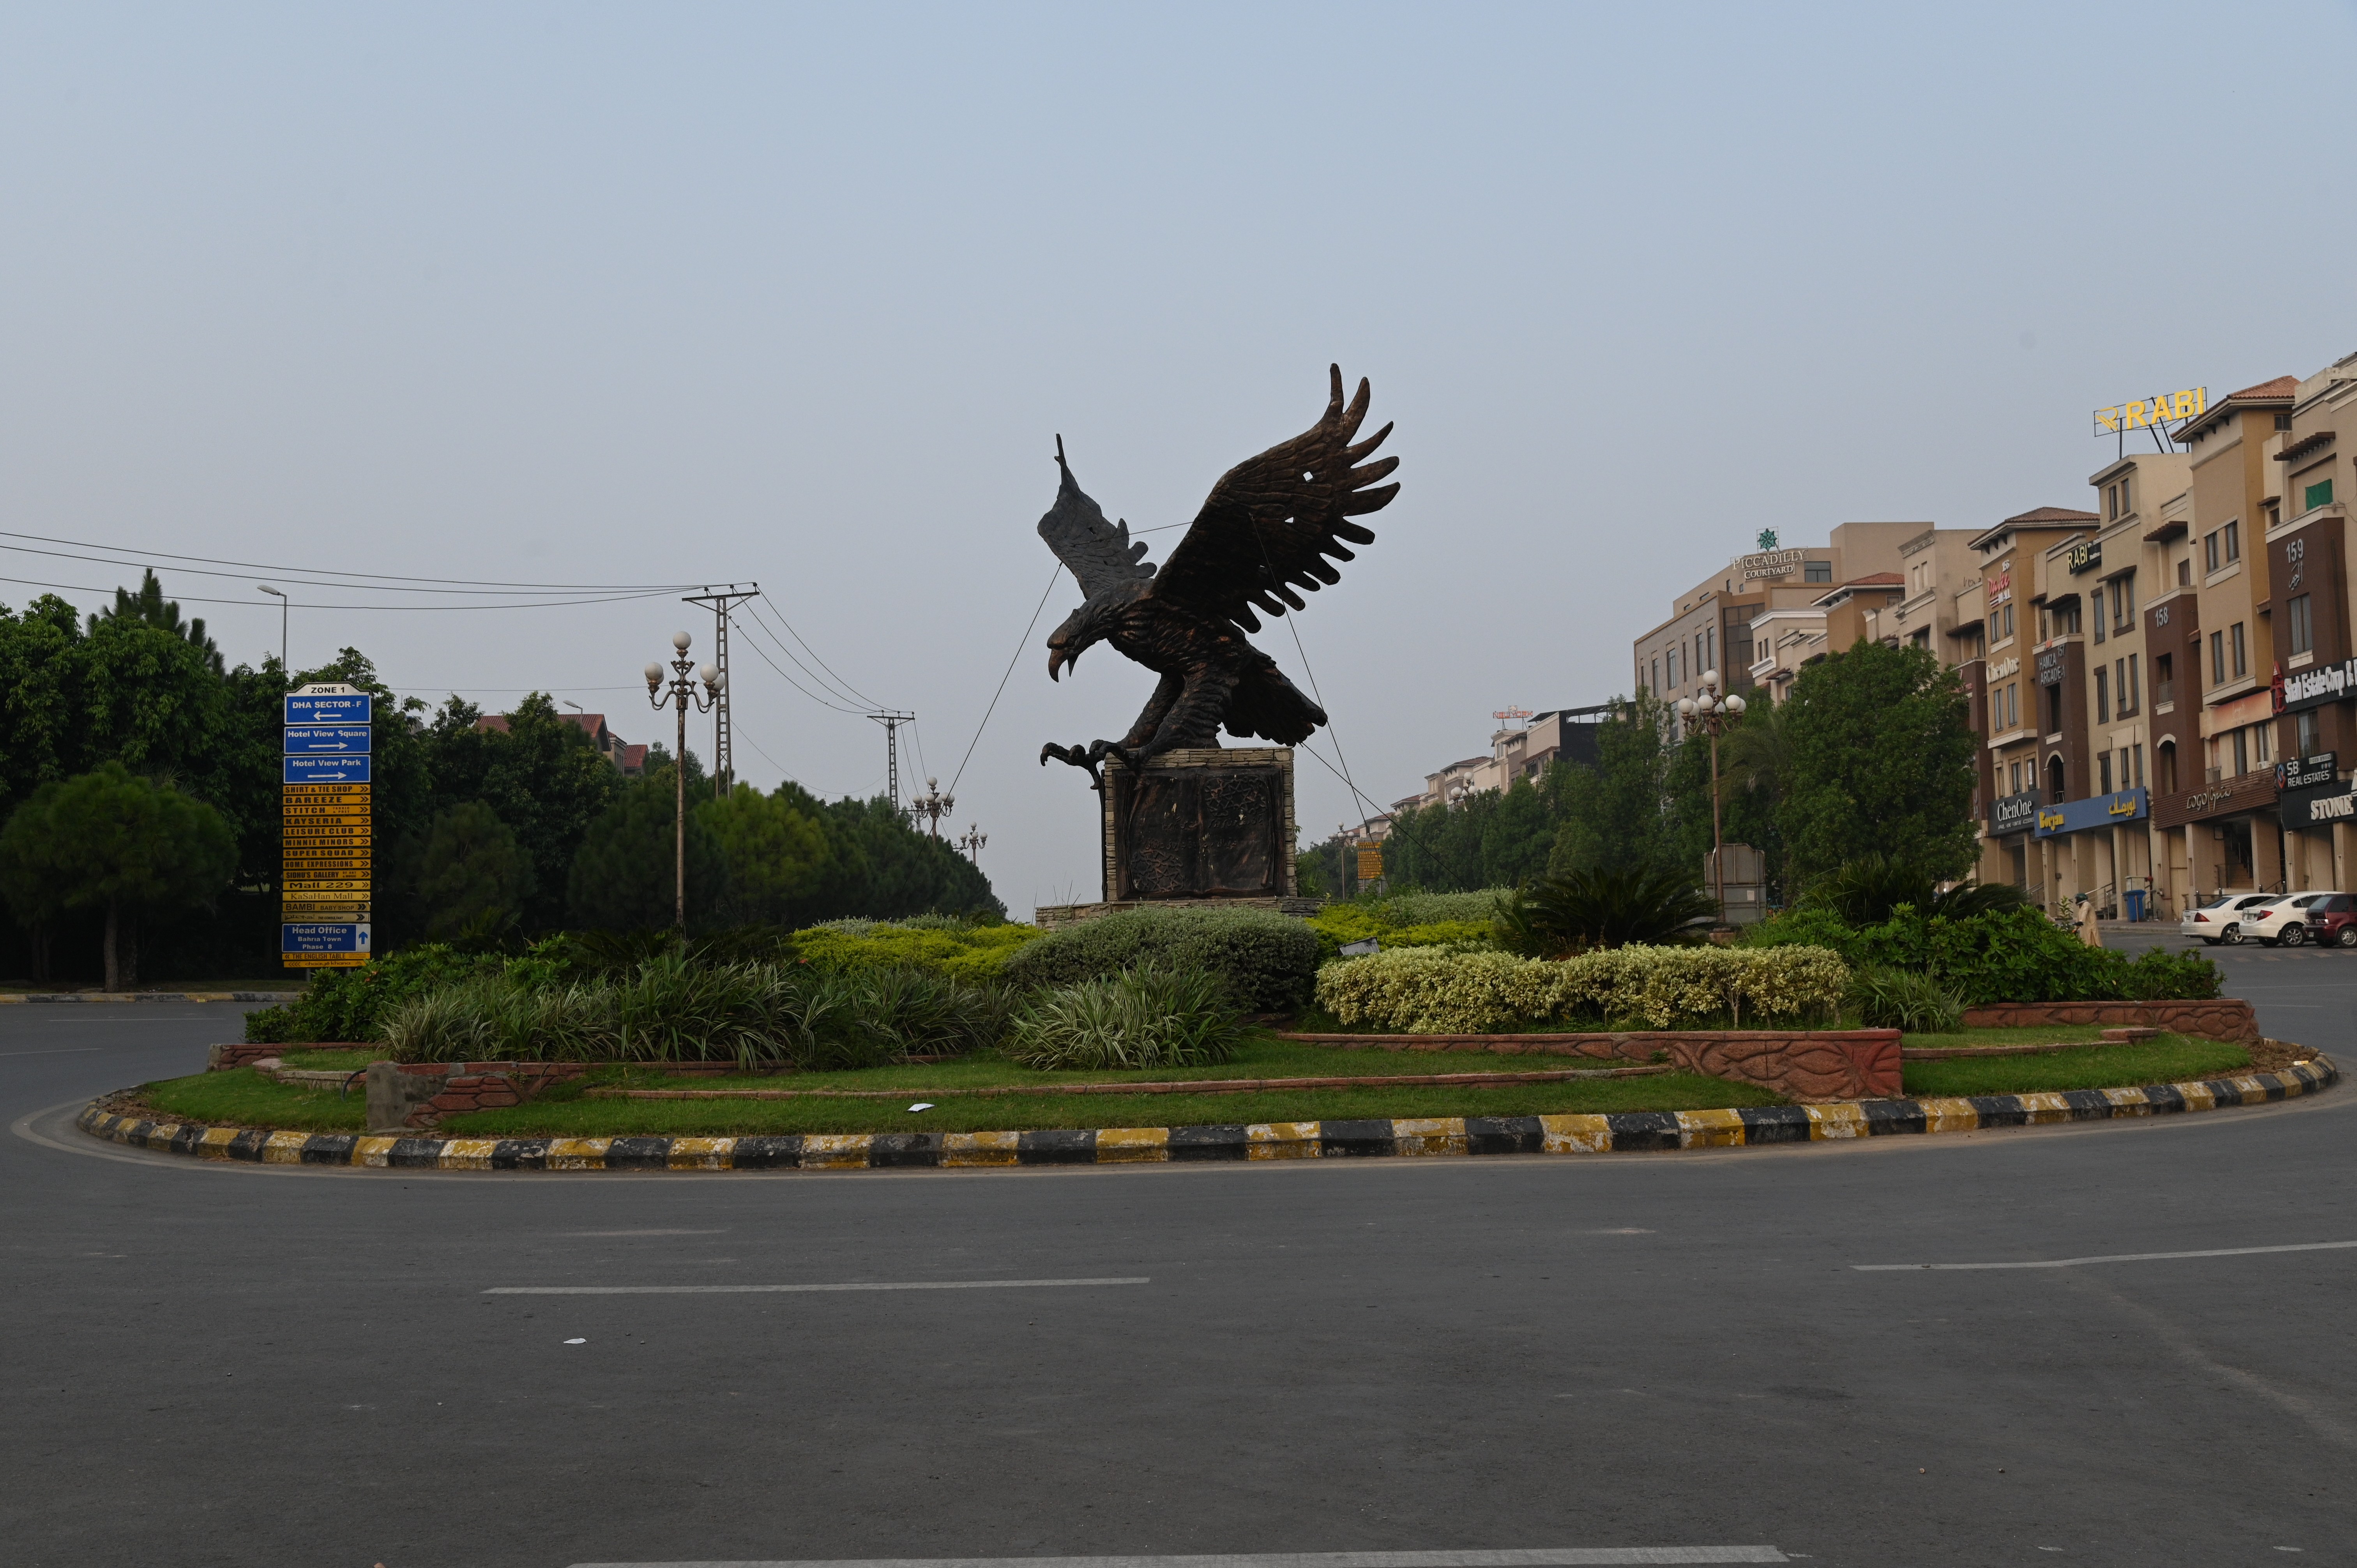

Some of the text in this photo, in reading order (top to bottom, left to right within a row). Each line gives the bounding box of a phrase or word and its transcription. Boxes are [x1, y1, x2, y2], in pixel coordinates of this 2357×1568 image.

[2126, 387, 2204, 429] RABI
[2067, 544, 2087, 570] RABI
[2286, 538, 2304, 563] 159
[1744, 565, 1793, 579] COURTYARD
[2155, 607, 2168, 628] 158
[1986, 657, 2020, 684] ChenOne
[2039, 653, 2056, 671] HAMZA
[2287, 761, 2299, 776] SB
[2288, 770, 2329, 788] REAL ESTATES
[1997, 799, 2032, 821] ChenOne
[2311, 794, 2353, 820] STONE
